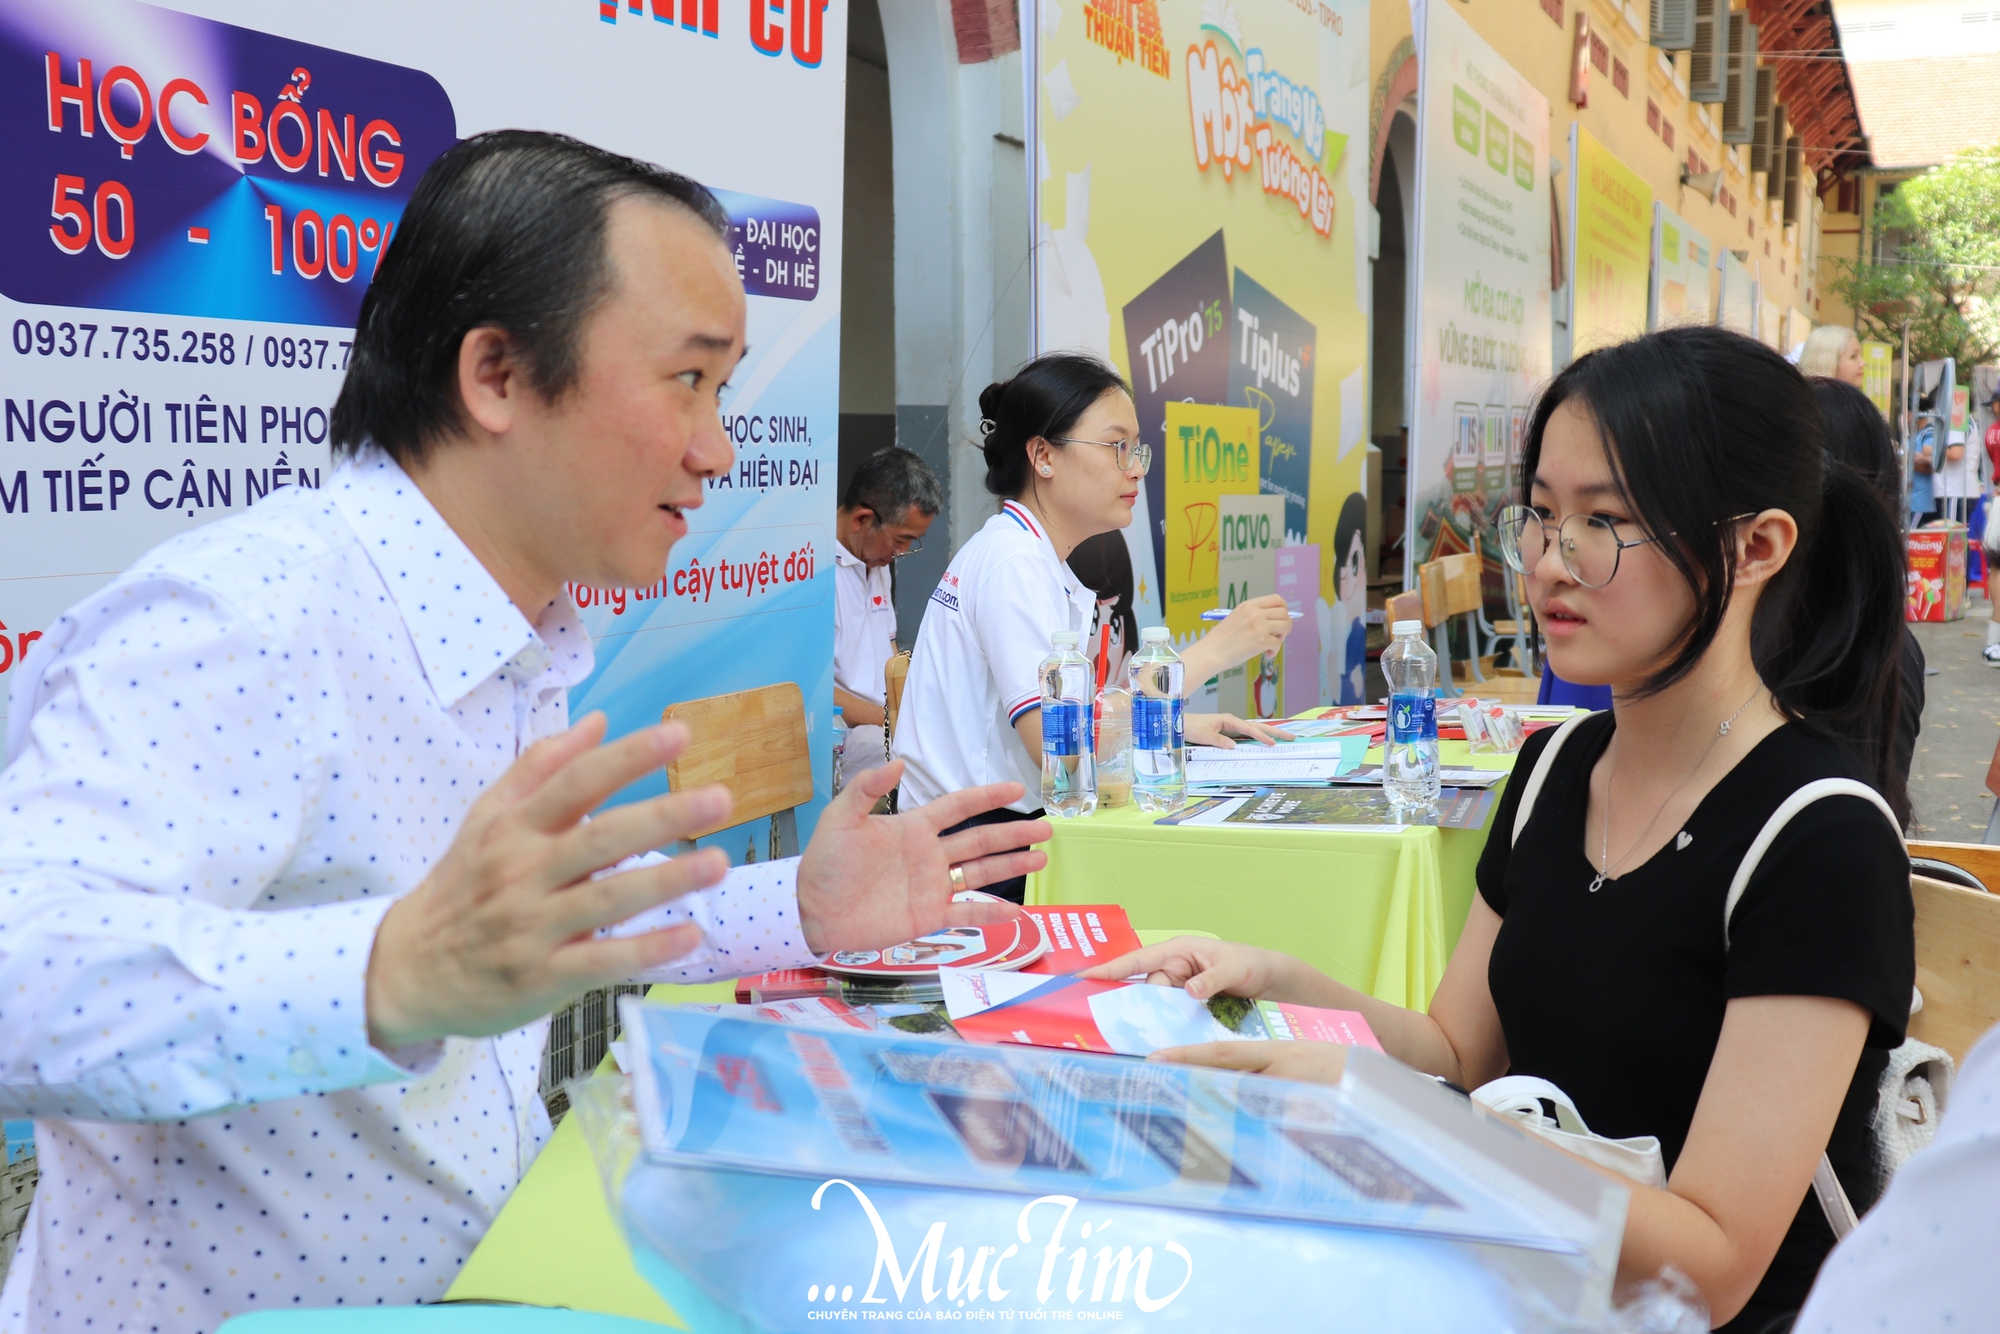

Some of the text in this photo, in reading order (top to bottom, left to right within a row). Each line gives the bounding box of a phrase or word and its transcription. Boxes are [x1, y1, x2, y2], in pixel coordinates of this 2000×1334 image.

[1318, 1, 1343, 37] TIPRO
[45, 51, 405, 188] HỌC BỔNG
[1186, 39, 1254, 183] Một
[1246, 47, 1302, 139] Trang
[49, 174, 136, 260] 50
[1311, 164, 1334, 240] Lai
[746, 217, 776, 250] ĐẠI
[781, 222, 818, 255] HỌC
[766, 258, 788, 286] DH
[794, 258, 815, 289] HÈ
[12, 318, 235, 366] 0937.735.258
[1140, 298, 1223, 394] TiPro 75
[1238, 306, 1301, 397] Tiplus
[5, 389, 335, 444] NGƯỜI TIÊN PHO
[722, 415, 812, 448] HỌC SINH,
[740, 453, 782, 493] HIỆN
[789, 459, 819, 490] ĐẠI
[1178, 423, 1249, 483] TiOne
[43, 452, 130, 512] TIẾP
[144, 458, 232, 517] CẬN
[1222, 513, 1271, 552] navo
[674, 558, 716, 603] cậy
[720, 551, 779, 597] tuyệt
[784, 541, 815, 582] đối
[1048, 912, 1073, 950] EDUCATION
